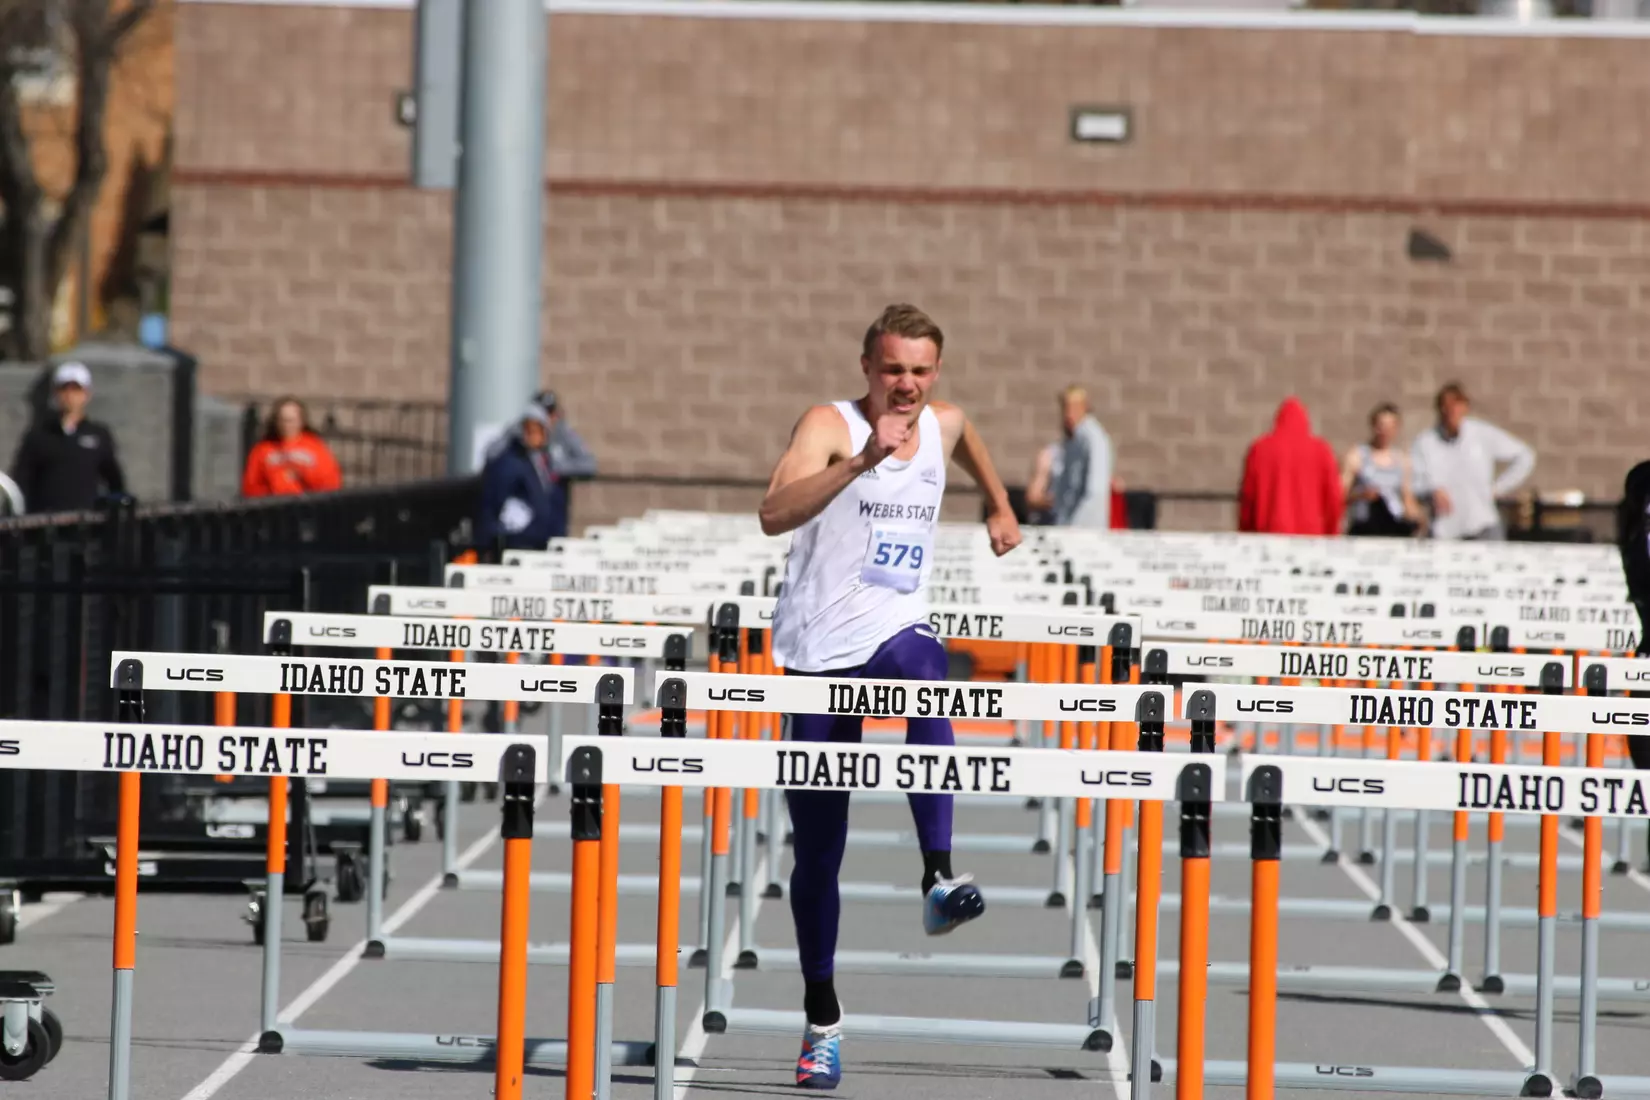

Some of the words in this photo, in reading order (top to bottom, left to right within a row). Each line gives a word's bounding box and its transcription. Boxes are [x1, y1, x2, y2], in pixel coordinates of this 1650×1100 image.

[859, 500, 904, 519] WEBER
[873, 542, 924, 570] 579
[492, 596, 546, 618] IDAHO
[555, 598, 614, 620] STATE
[1256, 597, 1309, 615] STATE
[310, 627, 356, 637] UCS
[929, 613, 1004, 638] STATE
[1048, 626, 1094, 636] UCS
[1241, 618, 1295, 641] IDAHO
[1302, 620, 1363, 643] STATE
[403, 624, 470, 648] IDAHO
[481, 627, 554, 651] STATE
[600, 638, 646, 648] UCS
[1606, 629, 1638, 649] IDA
[1187, 656, 1233, 666] UCS
[1280, 652, 1347, 676] IDAHO
[1358, 655, 1432, 680] STATE
[167, 668, 223, 681] UCS
[1478, 667, 1524, 676] UCS
[1625, 671, 1650, 681] UC
[280, 664, 363, 694] IDAHO
[376, 667, 466, 697] STATE
[521, 680, 577, 692] UCS
[709, 688, 764, 702] UCS
[828, 684, 906, 715] IDAHO
[917, 687, 1002, 717] STATE
[1060, 699, 1116, 711] UCS
[1237, 700, 1293, 713] UCS
[1350, 695, 1433, 725] IDAHO
[1445, 698, 1537, 729] STATE
[1592, 712, 1649, 725] UCS
[103, 732, 203, 770] IDAHO
[218, 736, 327, 774] STATE
[402, 753, 473, 768] UCS
[633, 757, 703, 773] UCS
[776, 751, 880, 788] IDAHO
[897, 754, 1010, 792] STATE
[1082, 771, 1152, 786] UCS
[1314, 778, 1384, 794] UCS
[1458, 772, 1563, 811] IDAHO
[1581, 778, 1648, 814] STA
[1316, 1065, 1374, 1077] UCS
